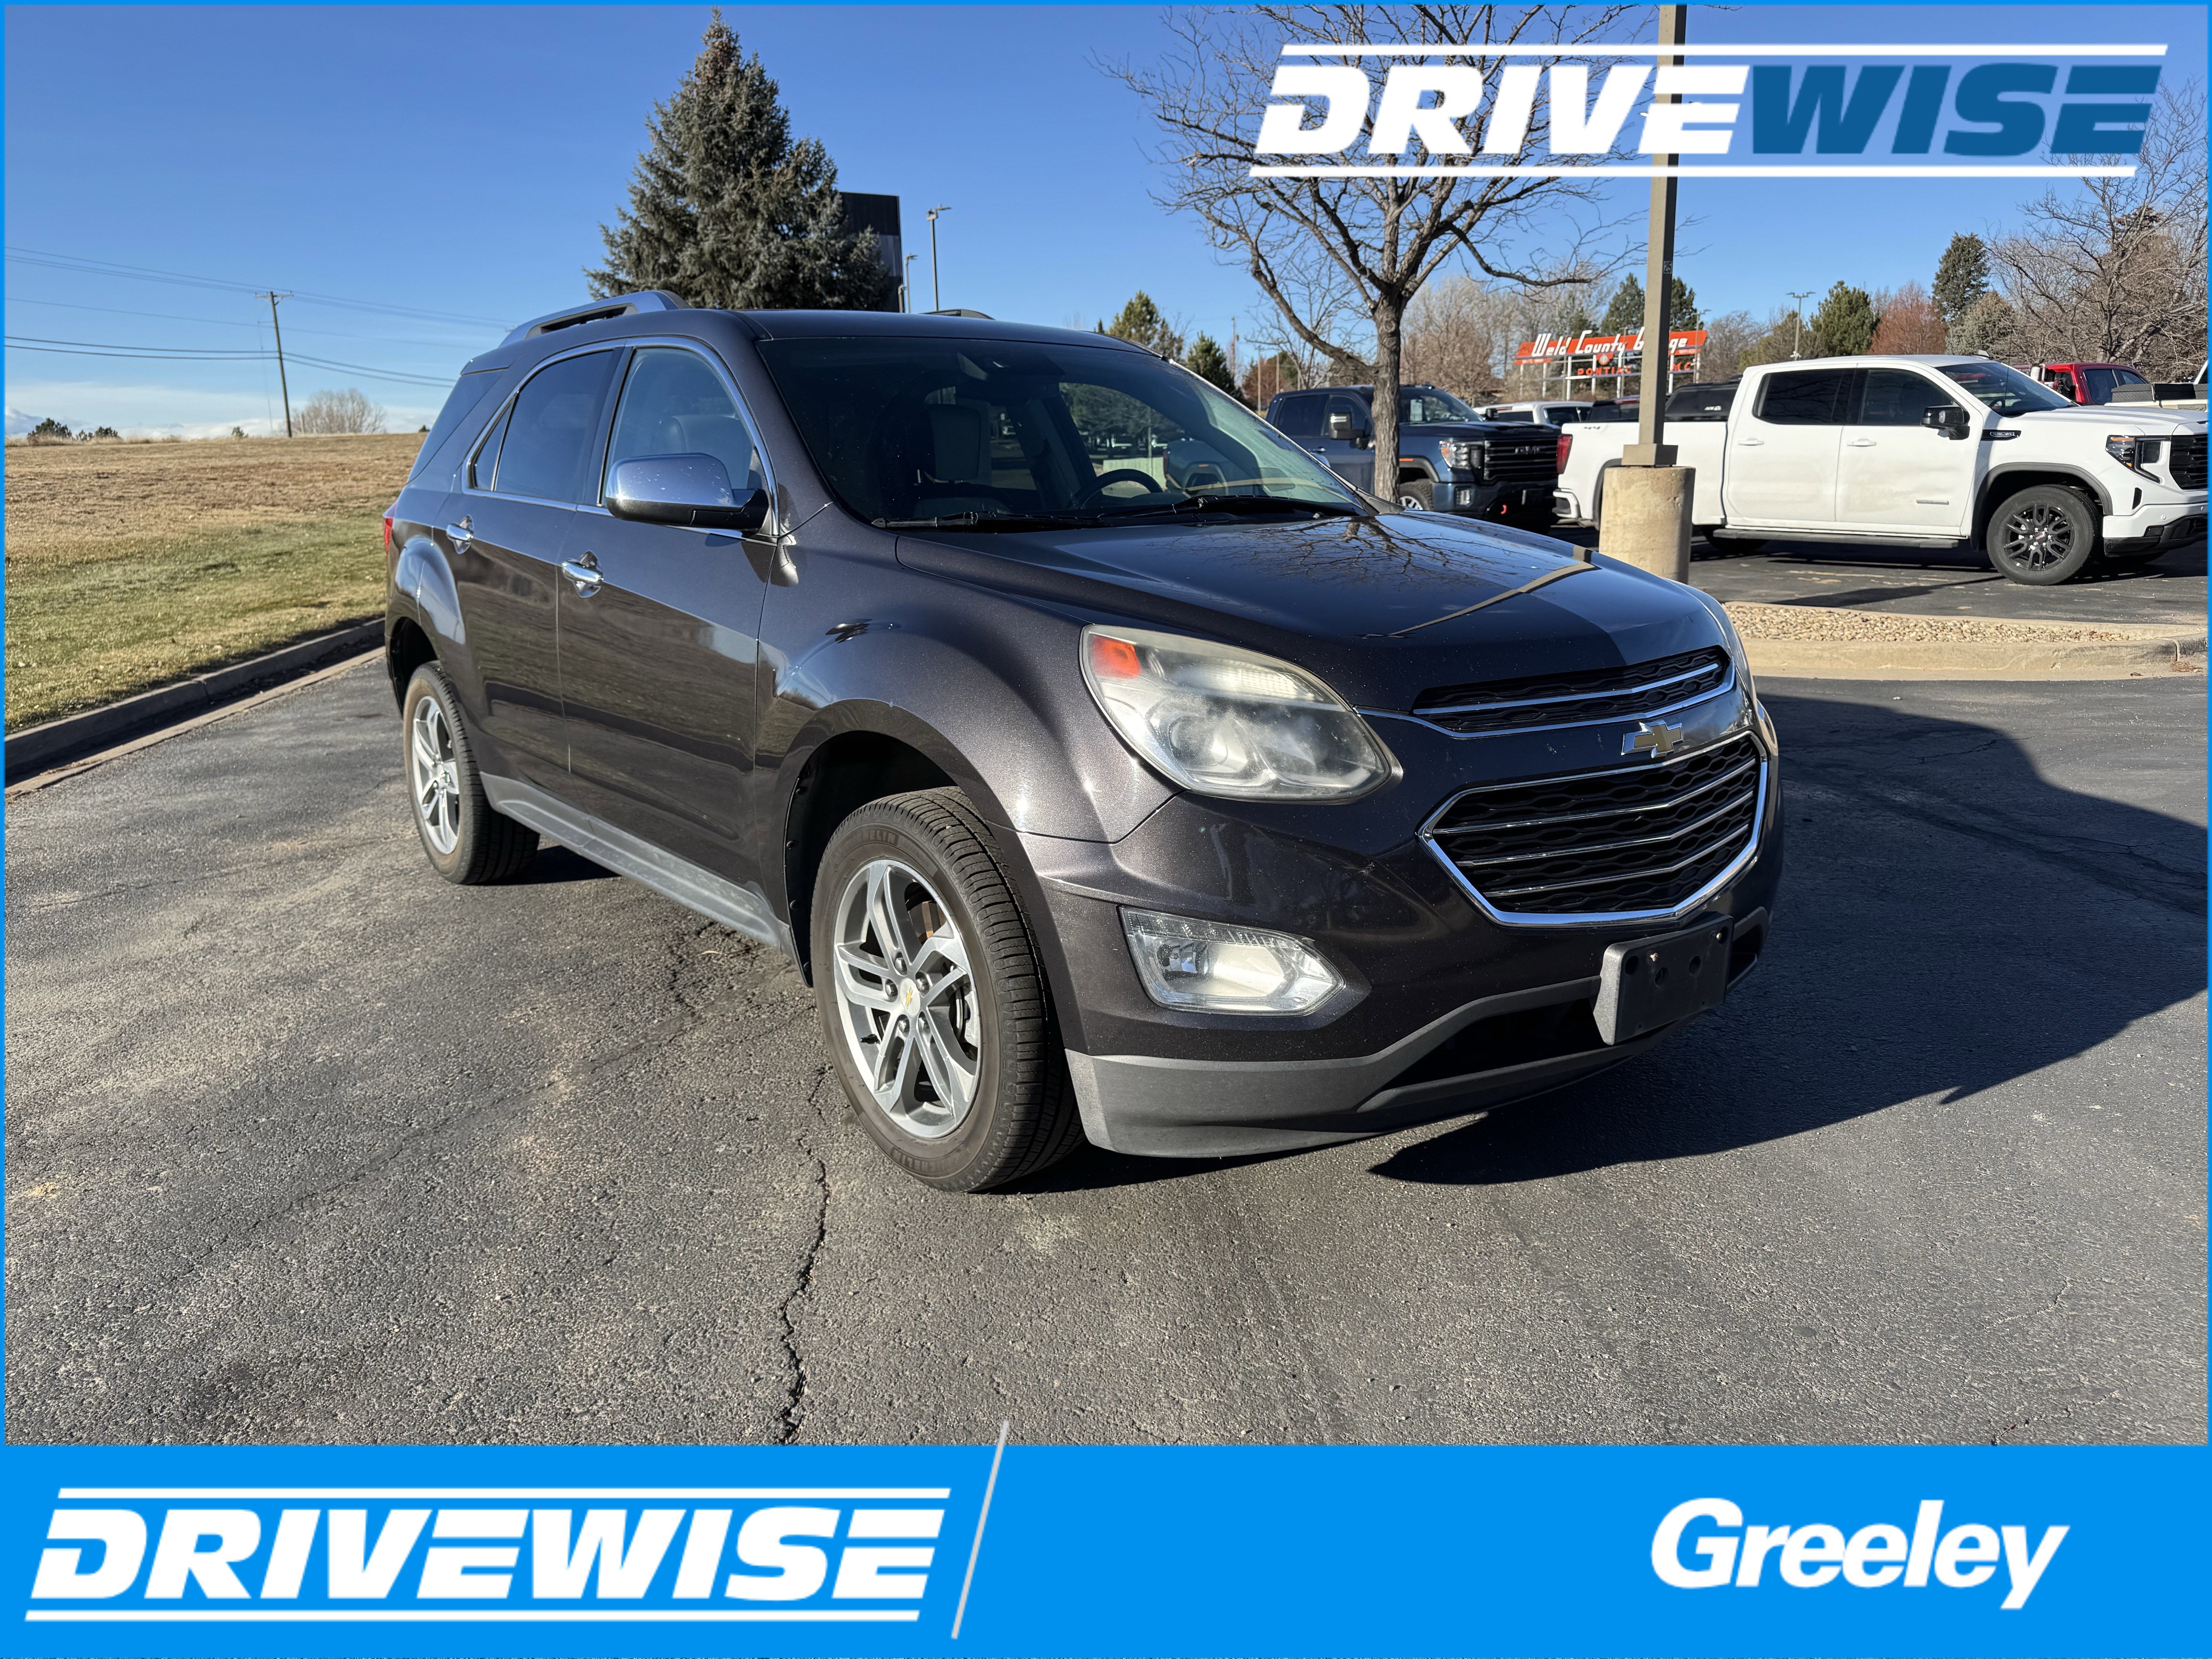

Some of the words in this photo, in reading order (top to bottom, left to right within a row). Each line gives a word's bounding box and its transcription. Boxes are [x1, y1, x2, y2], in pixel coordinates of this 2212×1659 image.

[1531, 333, 1572, 357] Weld
[1575, 330, 1626, 357] County
[1633, 326, 1688, 354] Gge
[1577, 365, 1632, 376] PONTIAC
[1671, 361, 1693, 372] MC
